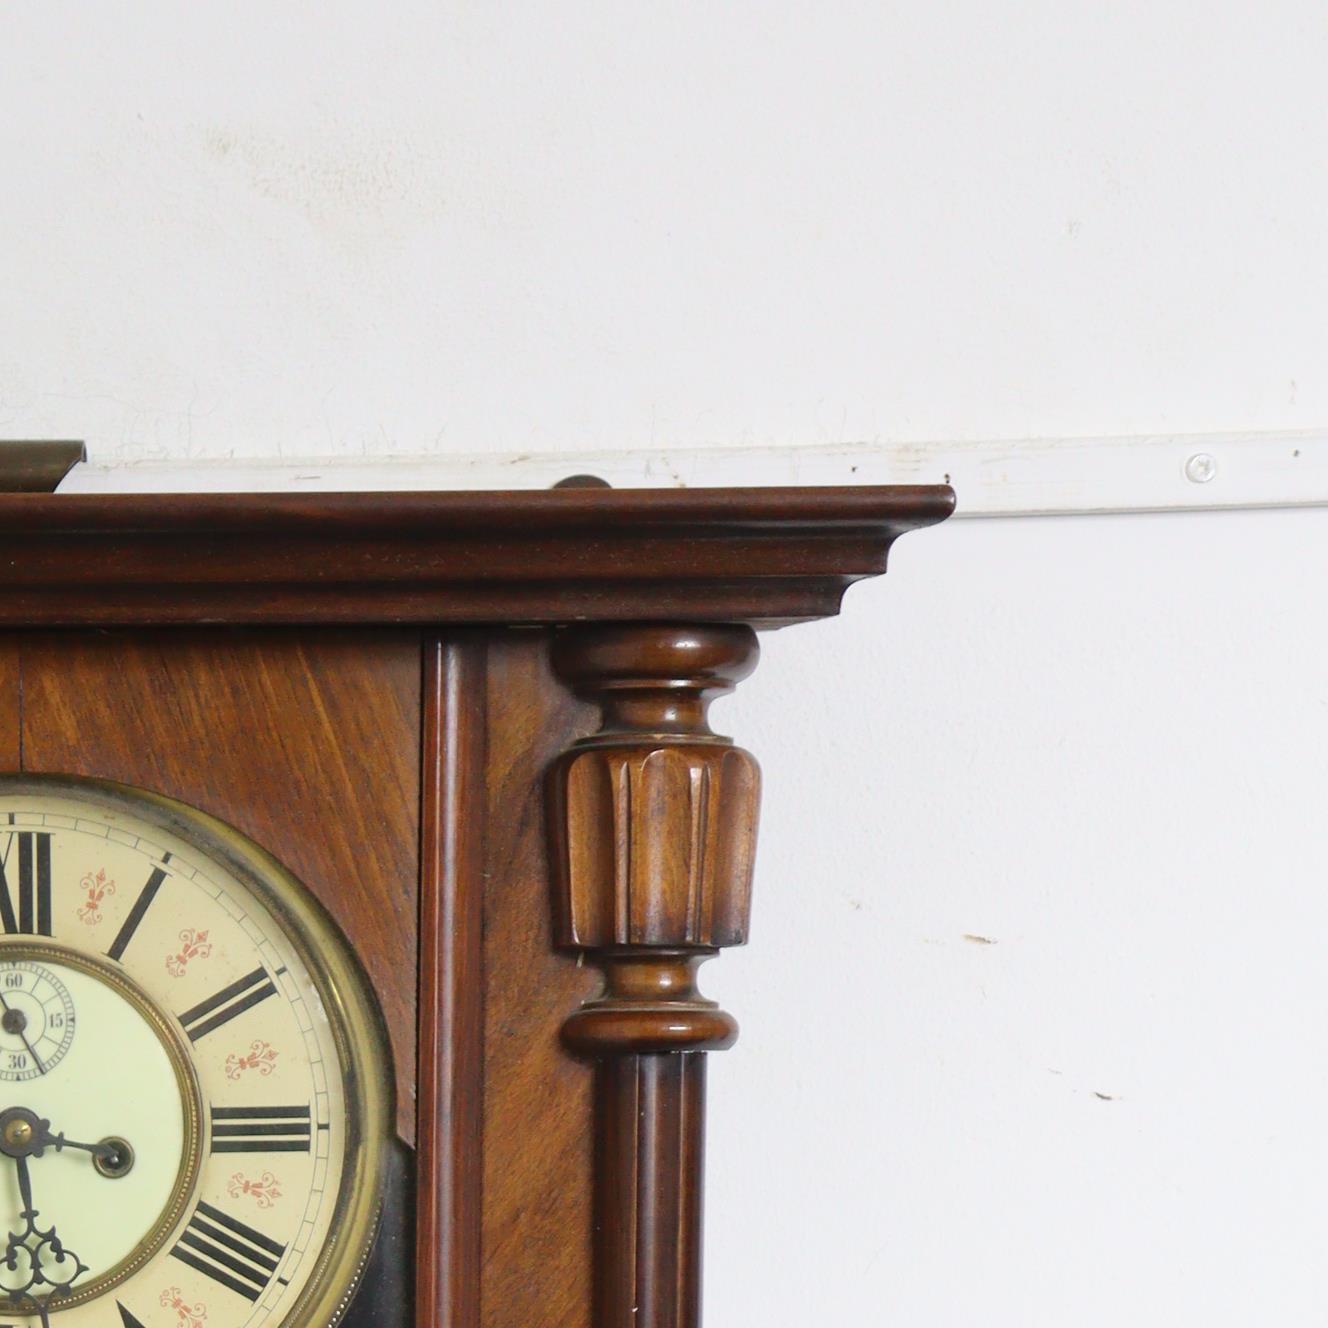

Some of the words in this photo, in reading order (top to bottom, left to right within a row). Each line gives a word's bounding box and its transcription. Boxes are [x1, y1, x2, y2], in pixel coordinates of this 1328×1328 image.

[103, 865, 174, 962] I
[5, 973, 23, 988] 60
[173, 964, 281, 1042] II
[49, 1013, 64, 1028] 15
[7, 1054, 27, 1069] 30
[210, 1105, 311, 1153] III
[169, 1199, 289, 1305] IIII
